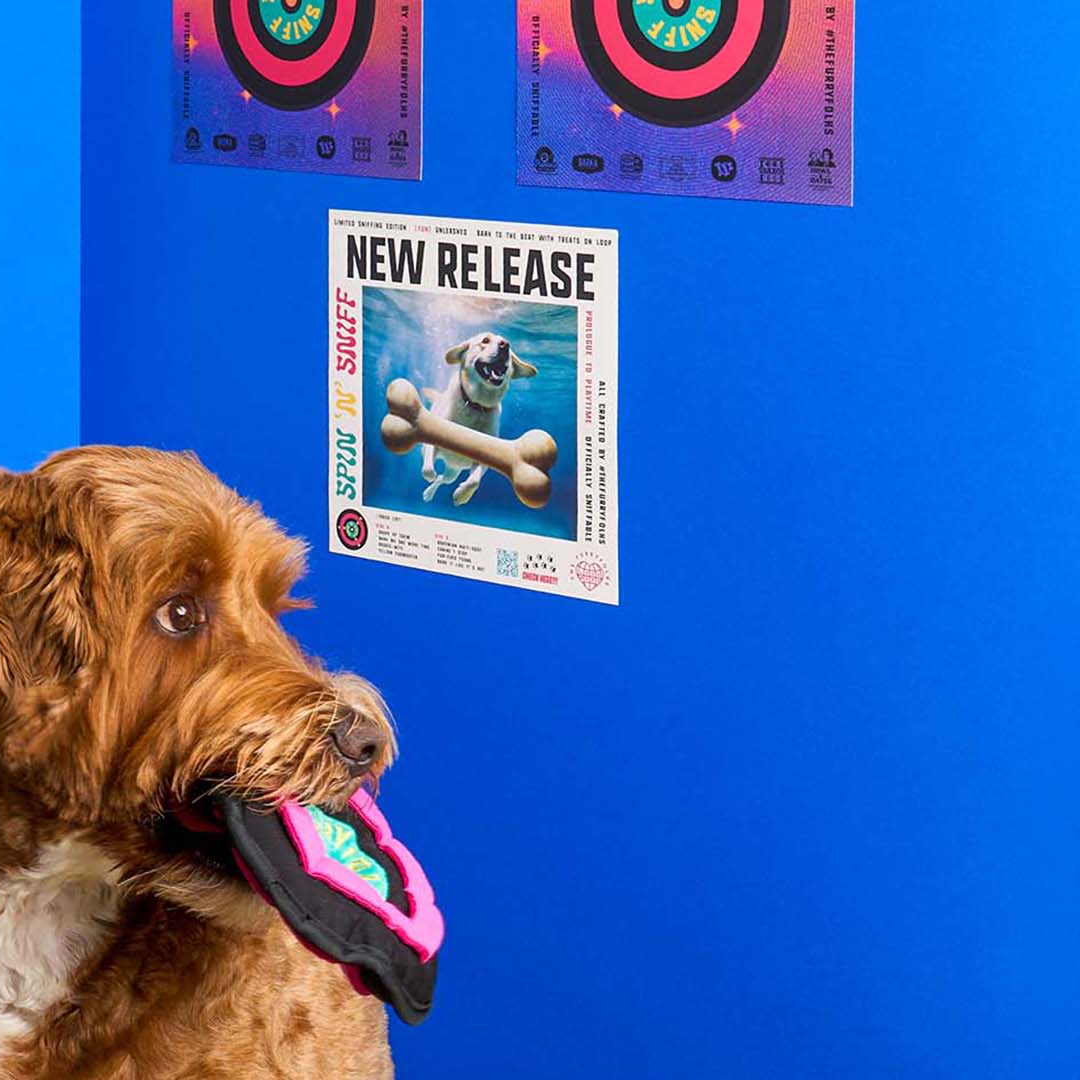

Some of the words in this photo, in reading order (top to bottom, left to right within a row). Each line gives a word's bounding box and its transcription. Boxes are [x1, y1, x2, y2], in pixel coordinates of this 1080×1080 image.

[270, 4, 320, 40] SNIFF
[648, 5, 716, 48] SNIFF
[825, 7, 836, 21] BY
[531, 15, 540, 75] OFFICIALLY
[824, 30, 836, 136] #THEFURRYFOLKS
[347, 234, 425, 284] NEW
[438, 242, 595, 301] RELEASE
[336, 287, 357, 375] SNIFF
[585, 310, 593, 355] PROLOGUE
[585, 379, 593, 423] PLAYTIME
[598, 380, 606, 396] ALL
[598, 403, 606, 443] CRAFTED
[336, 427, 356, 500] SPIN
[598, 449, 606, 460] BY
